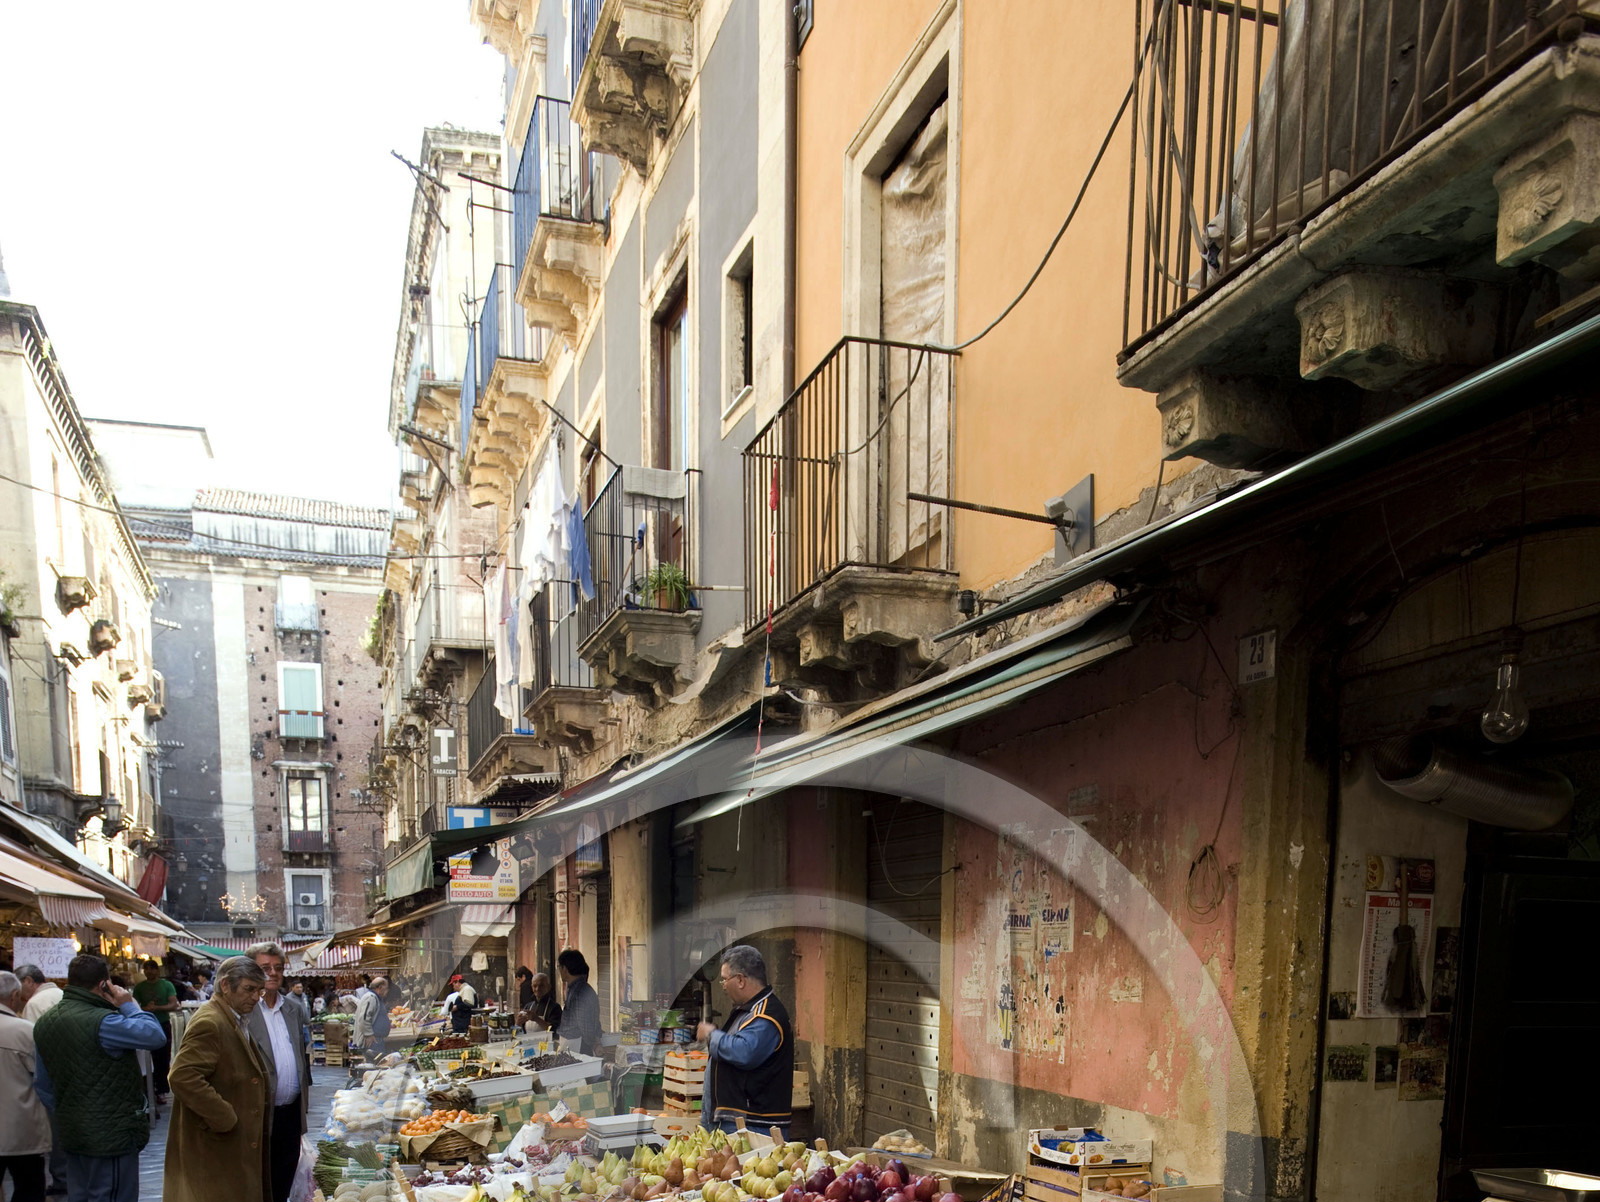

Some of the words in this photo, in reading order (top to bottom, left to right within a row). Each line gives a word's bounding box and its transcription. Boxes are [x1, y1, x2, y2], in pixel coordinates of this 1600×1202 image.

[1249, 636, 1265, 666] 23
[434, 730, 455, 763] T
[1387, 897, 1413, 908] Mao
